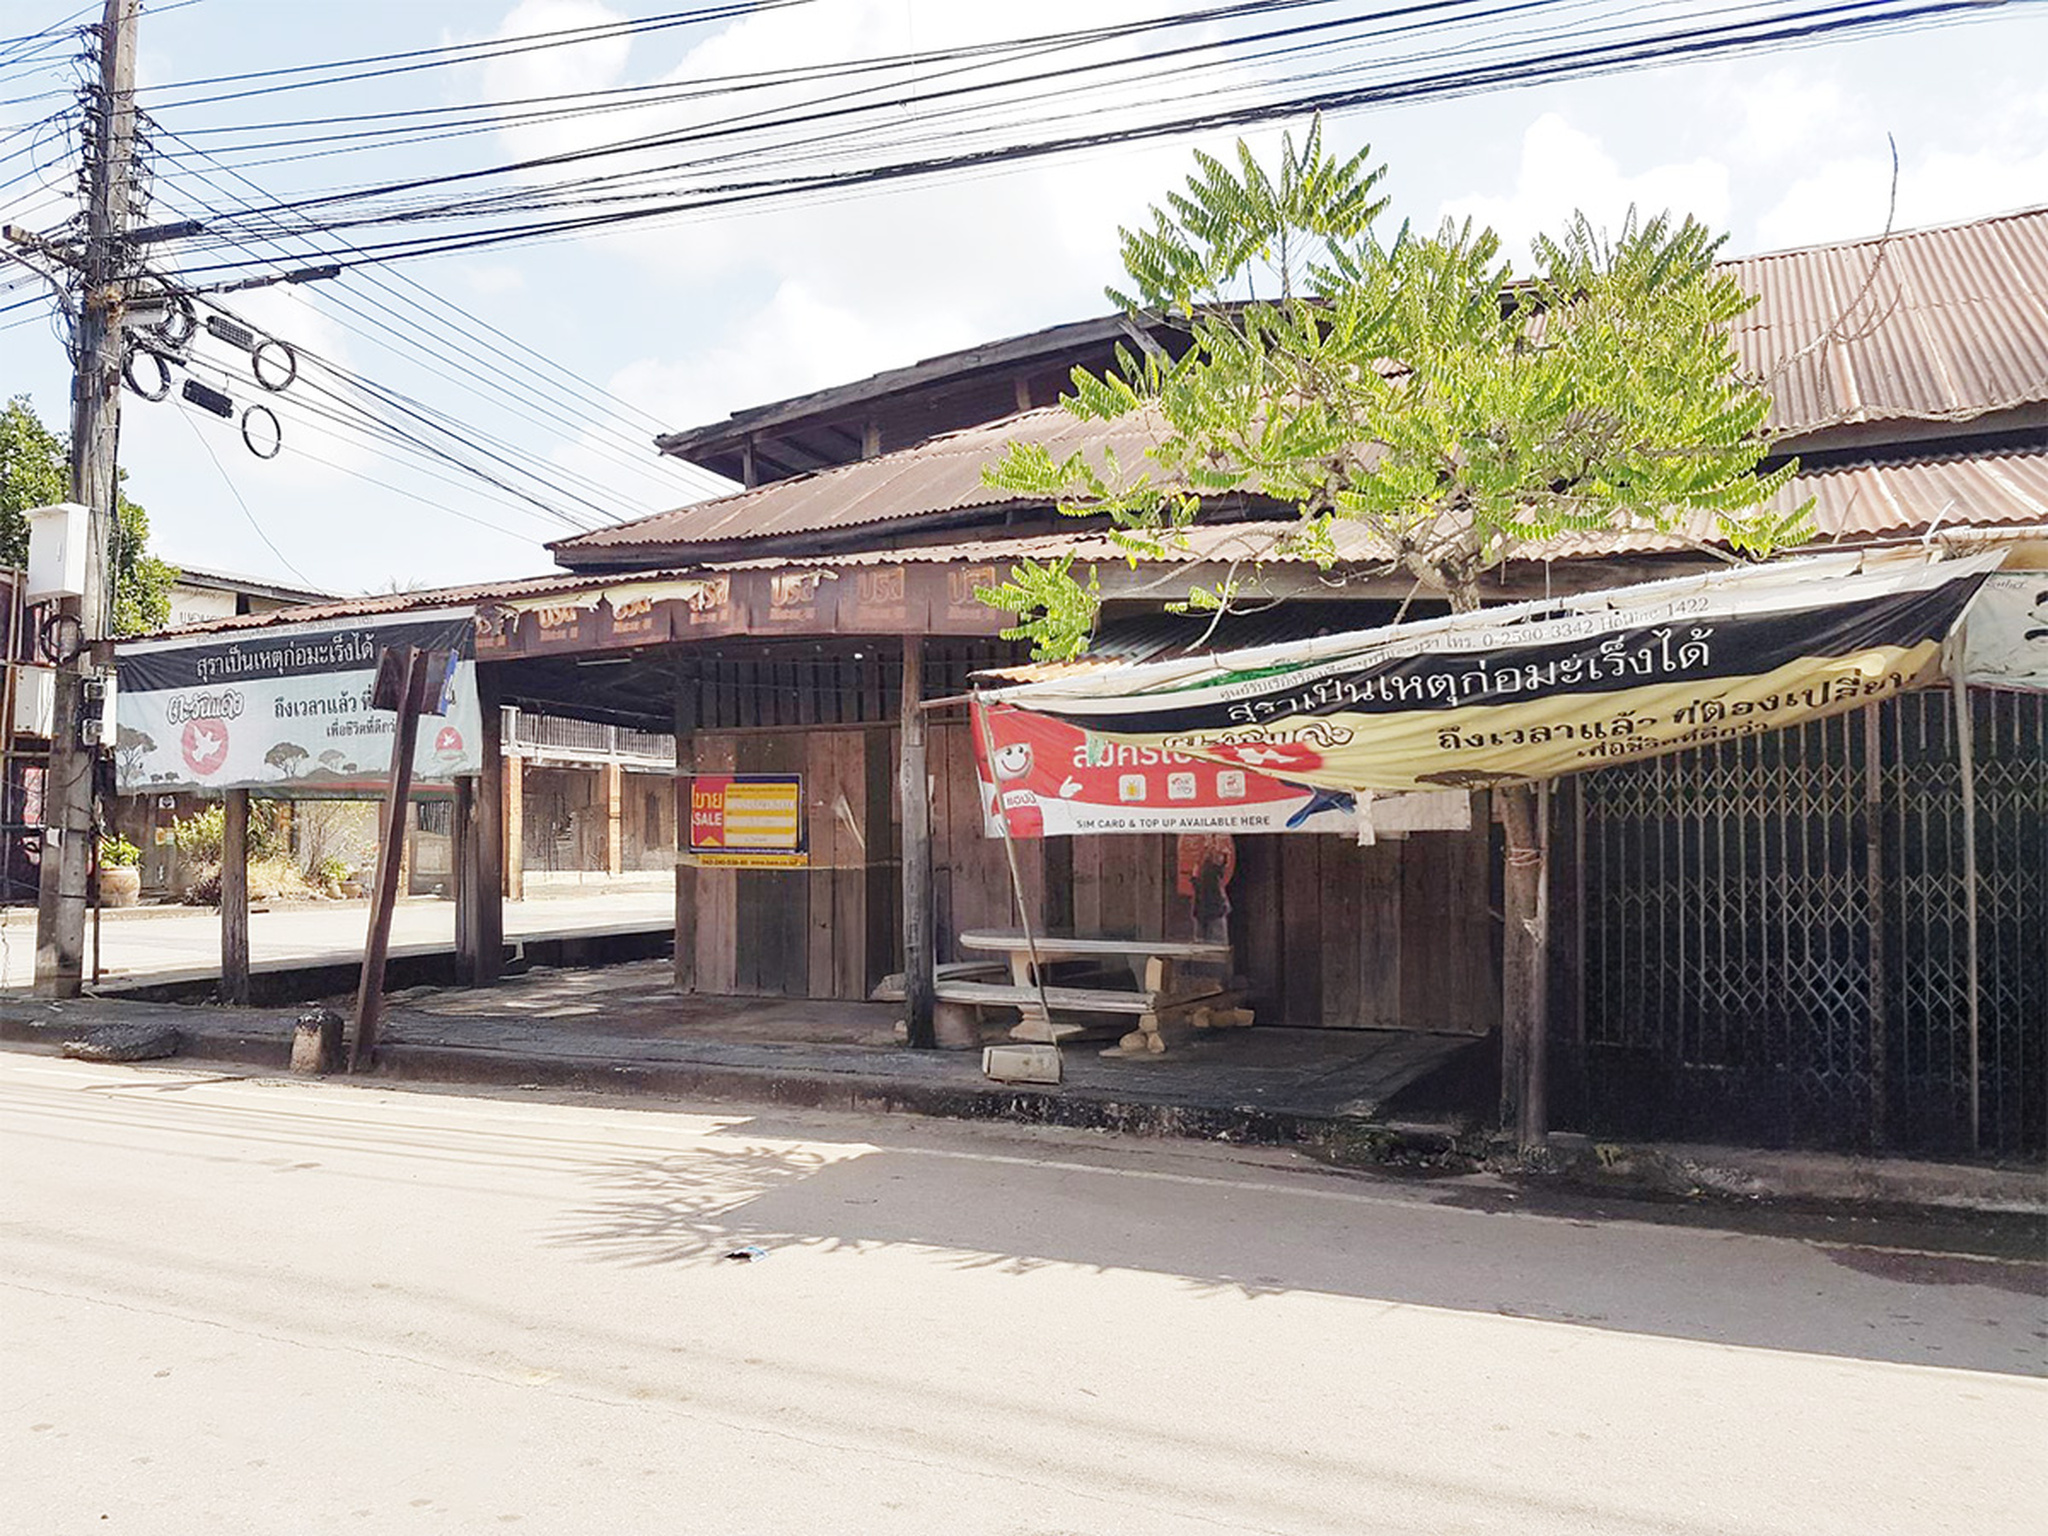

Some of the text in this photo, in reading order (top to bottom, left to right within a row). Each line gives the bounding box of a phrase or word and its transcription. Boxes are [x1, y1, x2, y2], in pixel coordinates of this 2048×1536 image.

[1667, 596, 1711, 617] 1422
[196, 632, 375, 683] สุราเป็นเหตุก่อมะเร็งได้
[1227, 626, 1715, 724] สุราเปนเหตุก่อมะเร็งได้
[325, 717, 397, 739] เพื่อชีวิตที่ดีกว่
[692, 791, 723, 809] ขาย
[692, 811, 723, 827] SALE
[1076, 815, 1271, 829] SIM CARD & TOP UP AVAILABLE HERE
